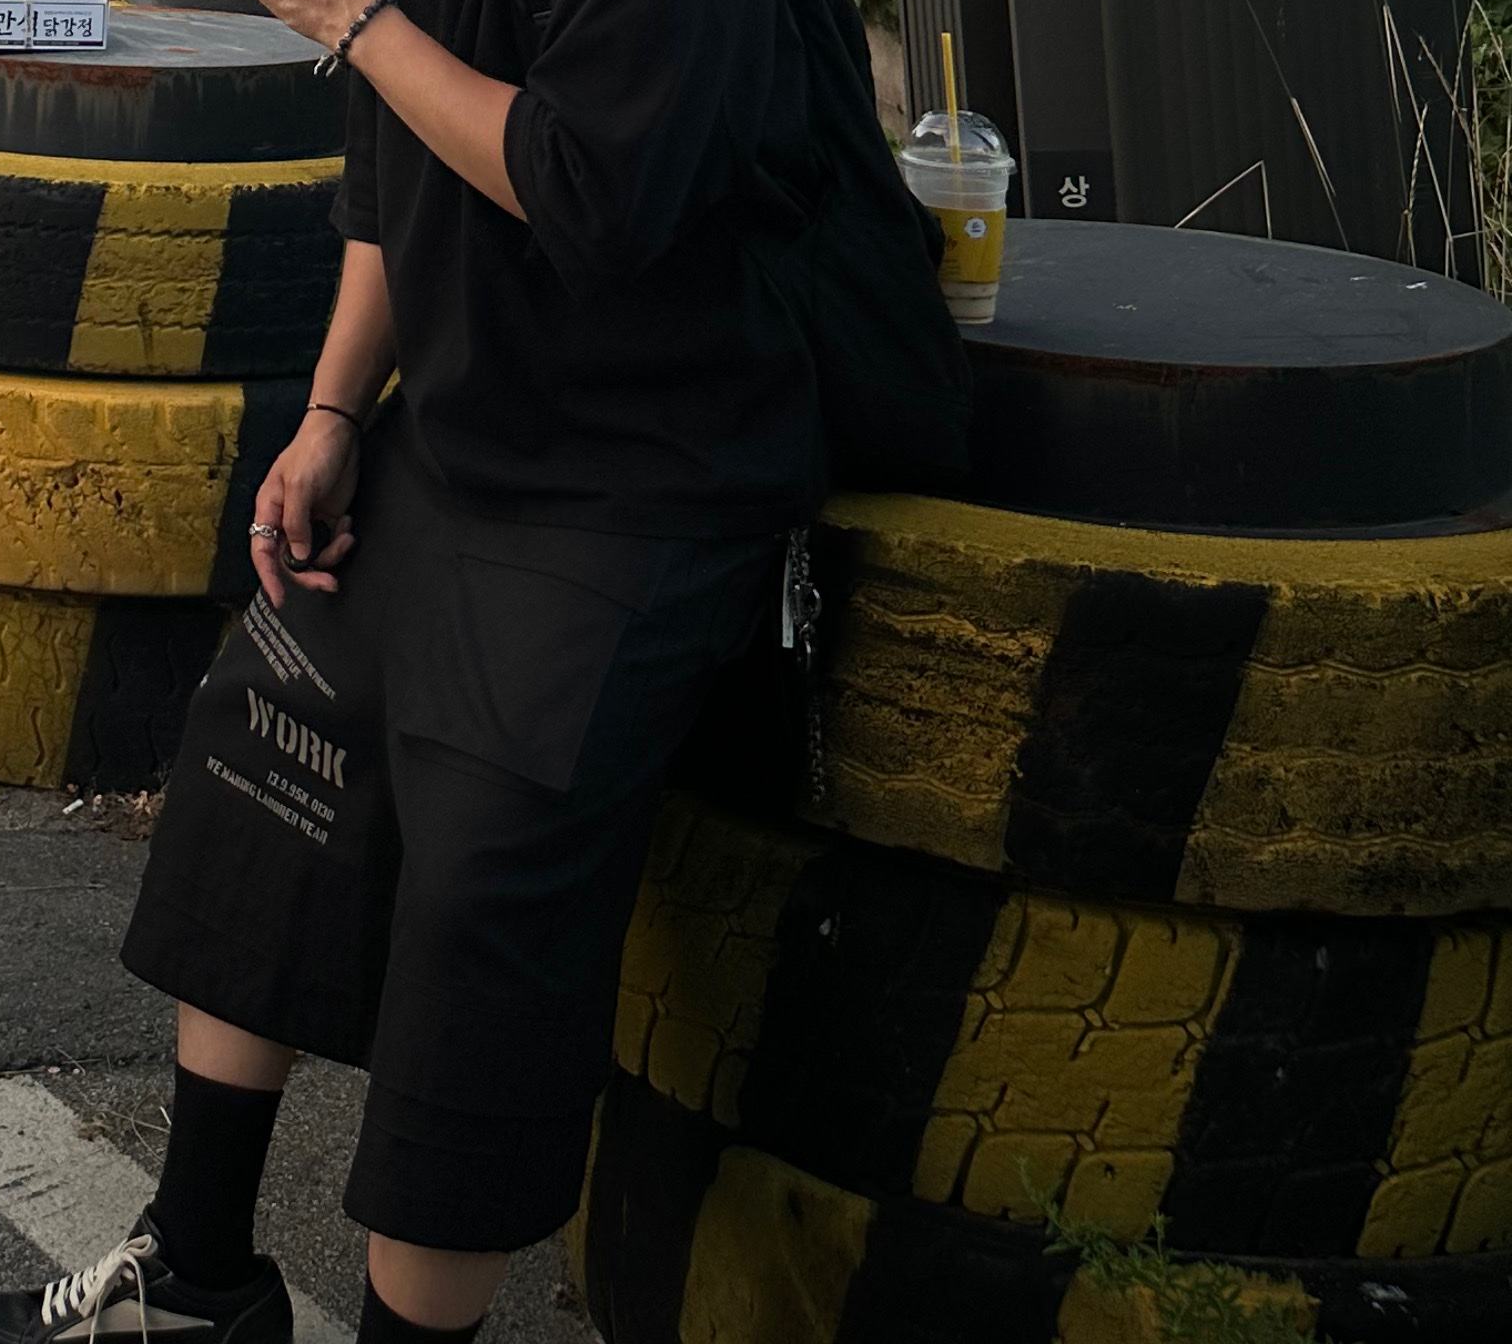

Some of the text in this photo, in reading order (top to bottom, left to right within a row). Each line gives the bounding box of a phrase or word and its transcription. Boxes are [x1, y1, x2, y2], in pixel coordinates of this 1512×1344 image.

[43, 16, 93, 38] 닭강정
[1058, 175, 1090, 208] 상
[246, 686, 348, 790] WORK
[205, 755, 221, 774] WE
